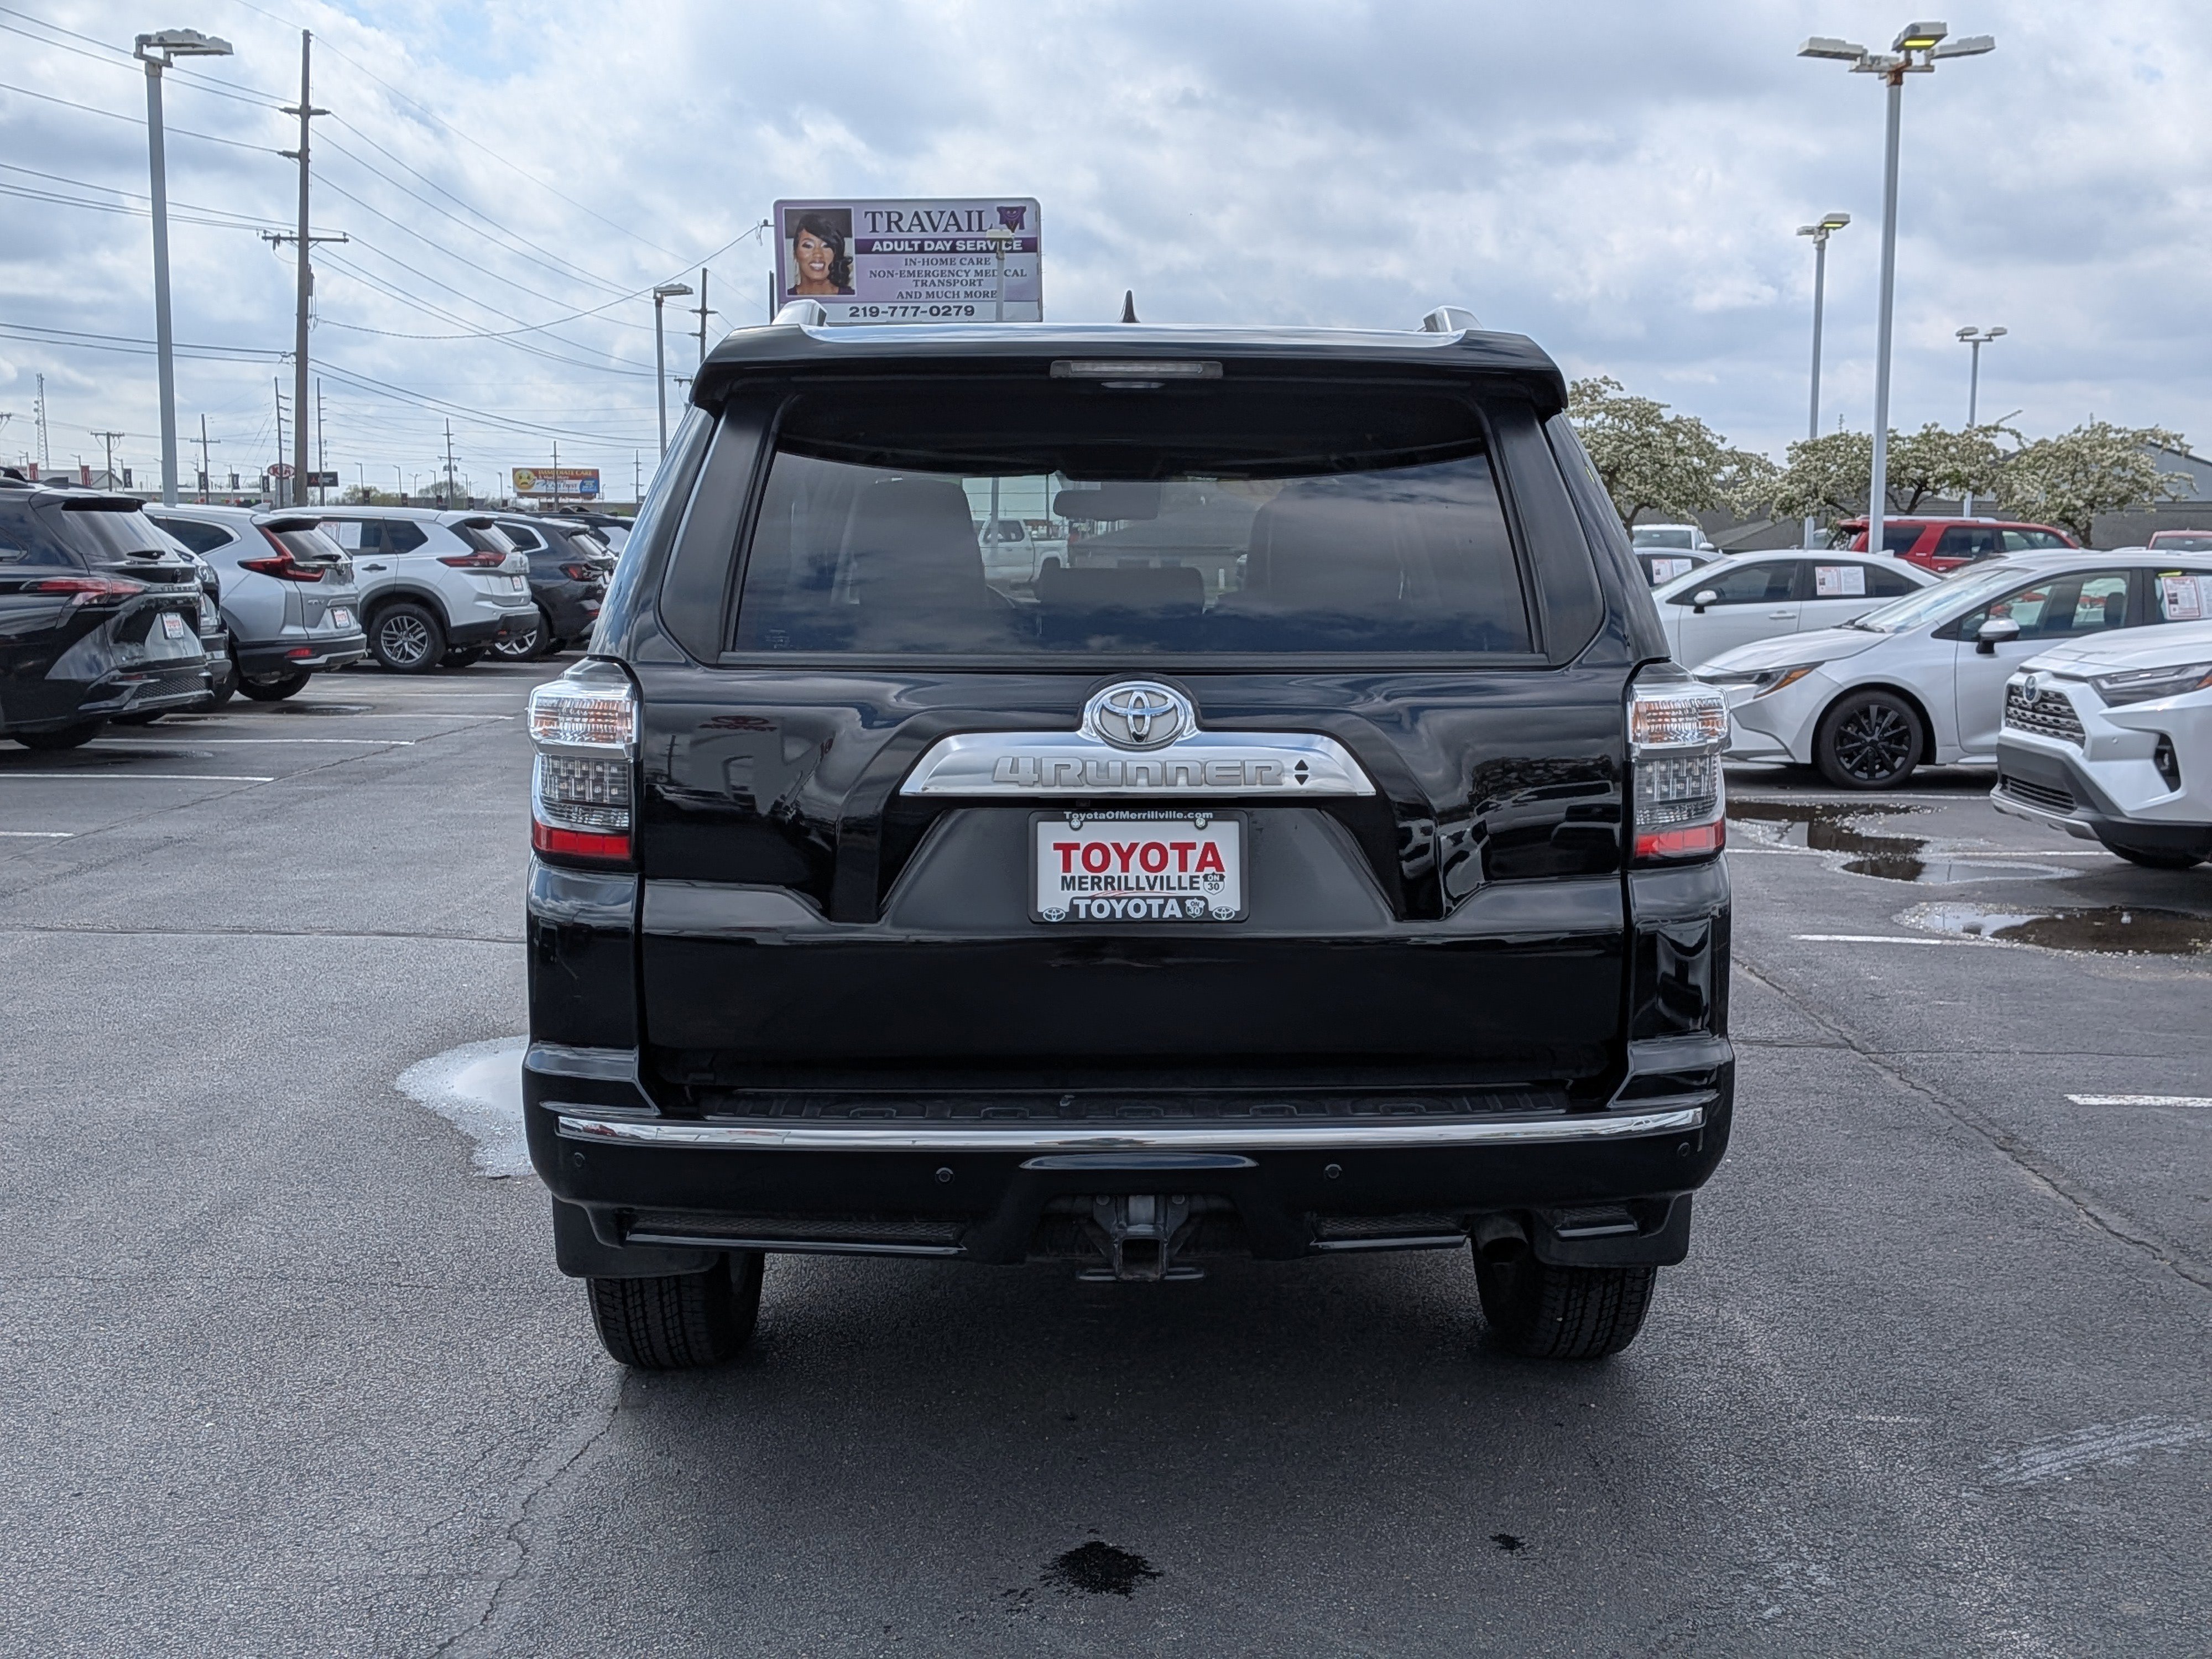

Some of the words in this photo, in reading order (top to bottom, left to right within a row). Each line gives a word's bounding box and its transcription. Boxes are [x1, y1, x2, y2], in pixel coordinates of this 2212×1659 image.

[864, 210, 993, 233] TRAVAIL
[872, 240, 921, 252] ADULT
[924, 240, 953, 251] DAY
[905, 257, 957, 266] IN-HOME
[959, 257, 991, 265] CARE
[869, 269, 971, 278] NON-EMERGENCY
[974, 268, 1027, 277] MEDCAL
[913, 279, 984, 287] TRANSPORT
[896, 291, 922, 299] AND
[925, 290, 960, 299] MUCH
[964, 290, 998, 299] MORE
[849, 305, 975, 317] 219-777-0279
[272, 466, 291, 475] KA
[1063, 811, 1213, 821] ToyotaOfMerrillville.com
[1053, 842, 1225, 873] TOYOTA
[1061, 875, 1201, 891] MERRILLVILLE
[1207, 883, 1220, 891] 30
[1073, 898, 1183, 919] TOYOTA
